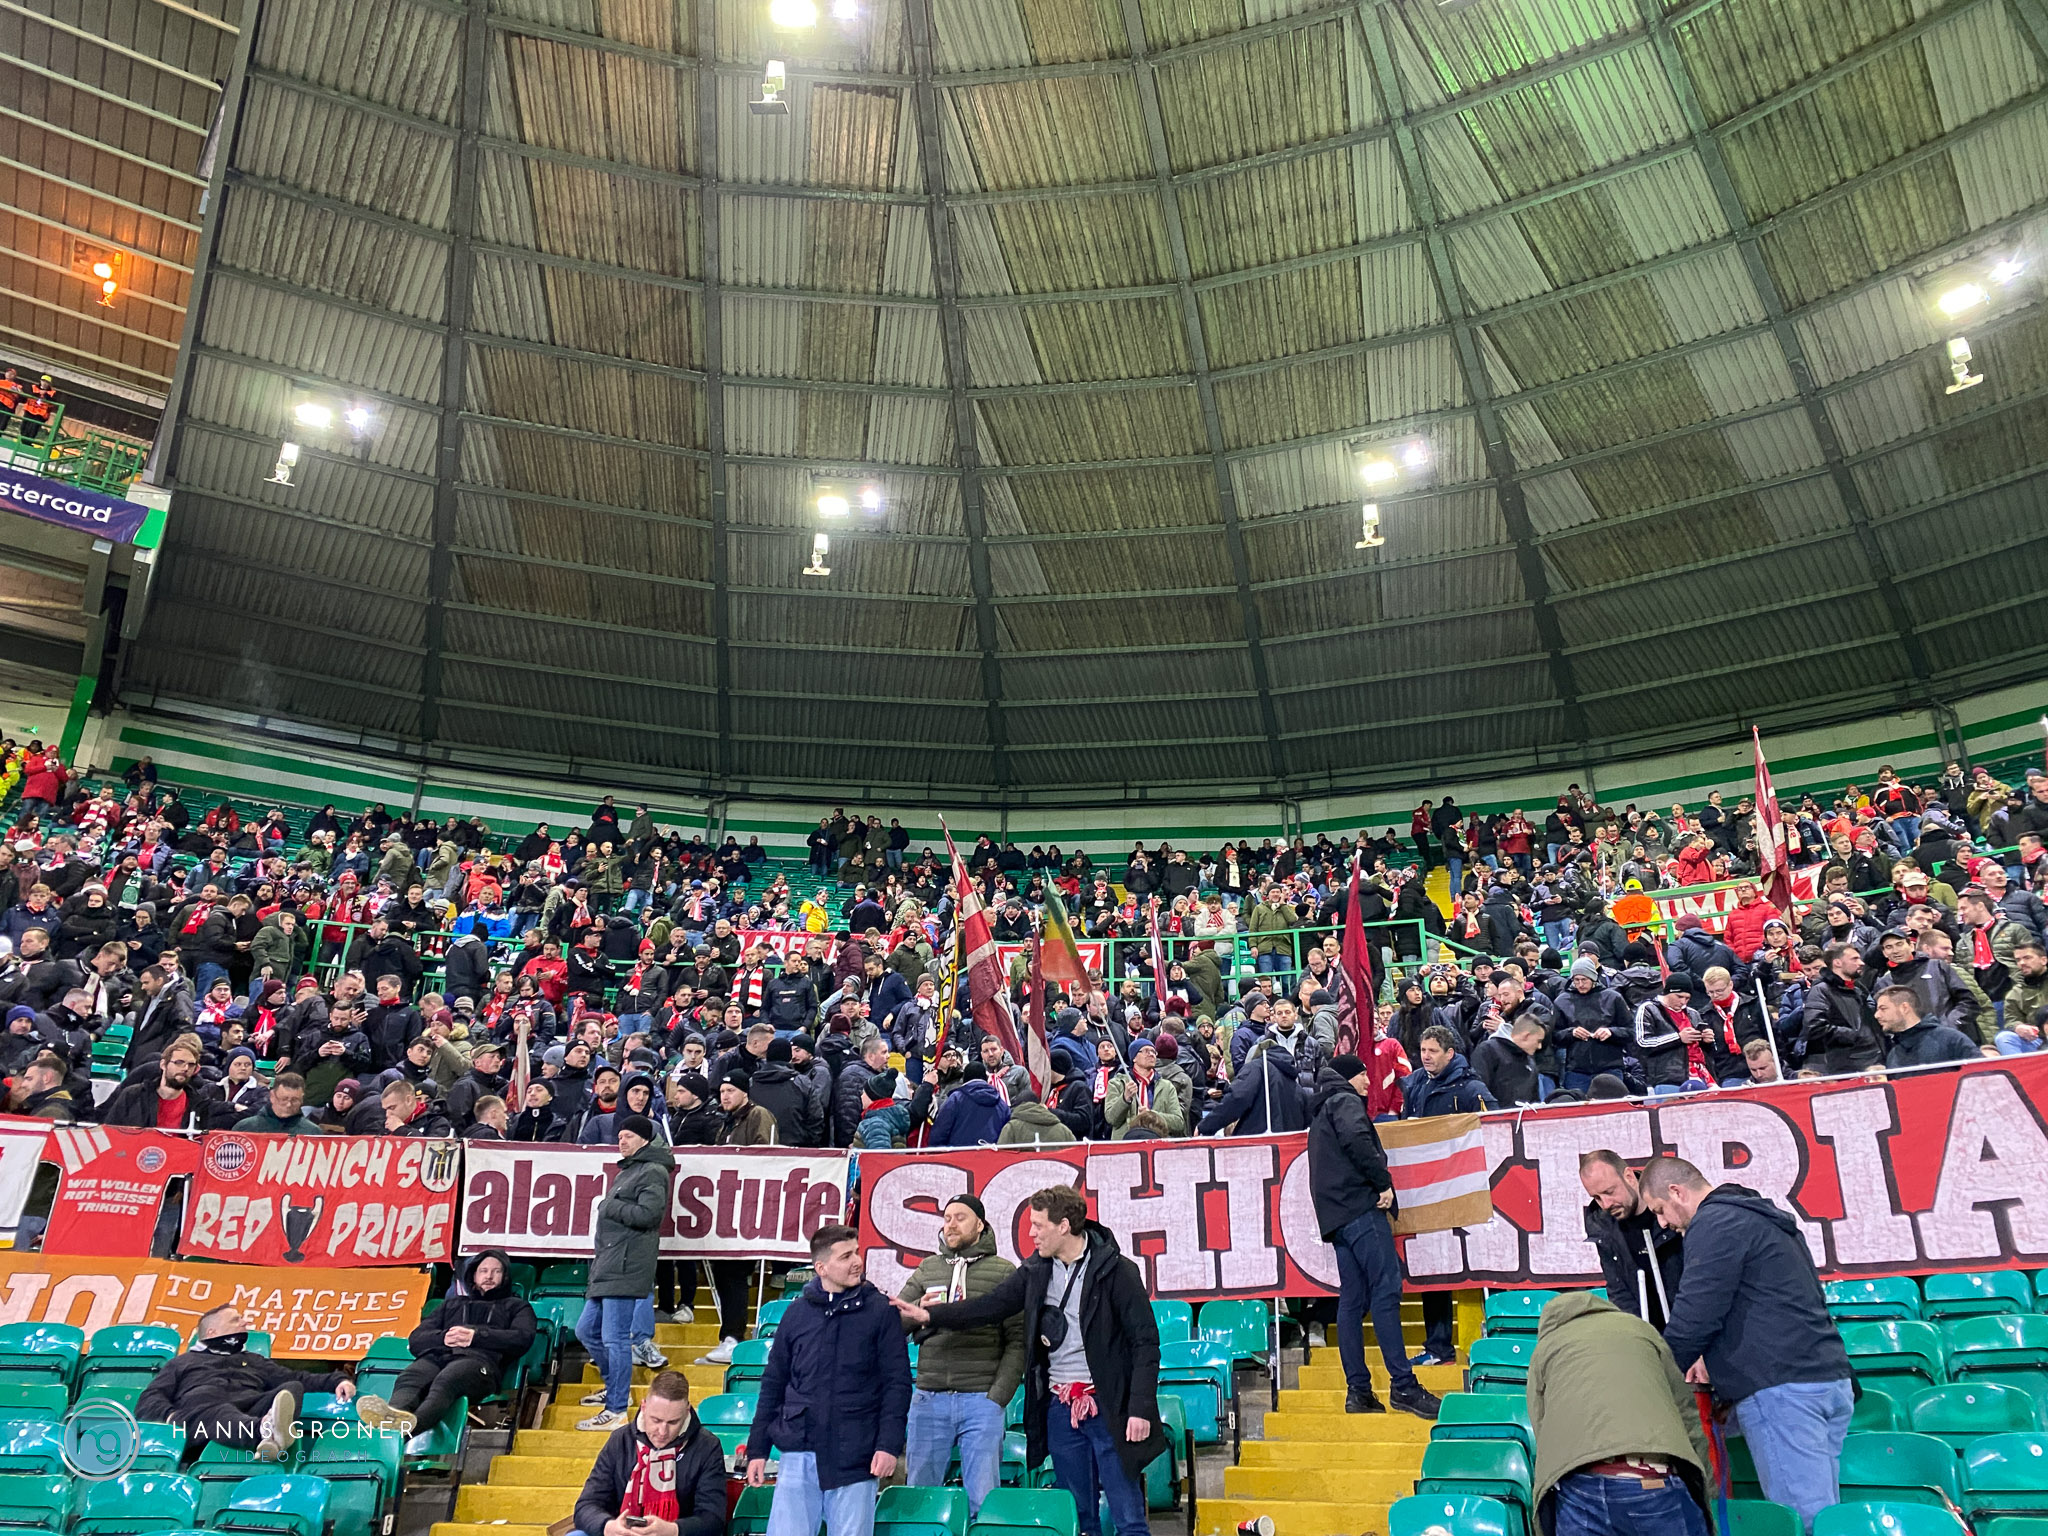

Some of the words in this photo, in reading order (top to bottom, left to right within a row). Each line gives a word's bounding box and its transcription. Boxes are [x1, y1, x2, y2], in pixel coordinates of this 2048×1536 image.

[223, 1135, 254, 1153] BAYERN
[256, 1139, 423, 1189] MUNICH'S
[67, 1179, 97, 1190] WIR
[101, 1180, 161, 1194] WOLLEN
[63, 1191, 157, 1206] ROT-WEISSE
[77, 1202, 140, 1216] TRIKOTS
[466, 1160, 841, 1242] alarstufe
[189, 1192, 273, 1252] RED
[326, 1201, 450, 1259] PRIDE
[167, 1274, 212, 1301] TO
[229, 1284, 409, 1312] MATCHES
[241, 1309, 344, 1332] EHIND
